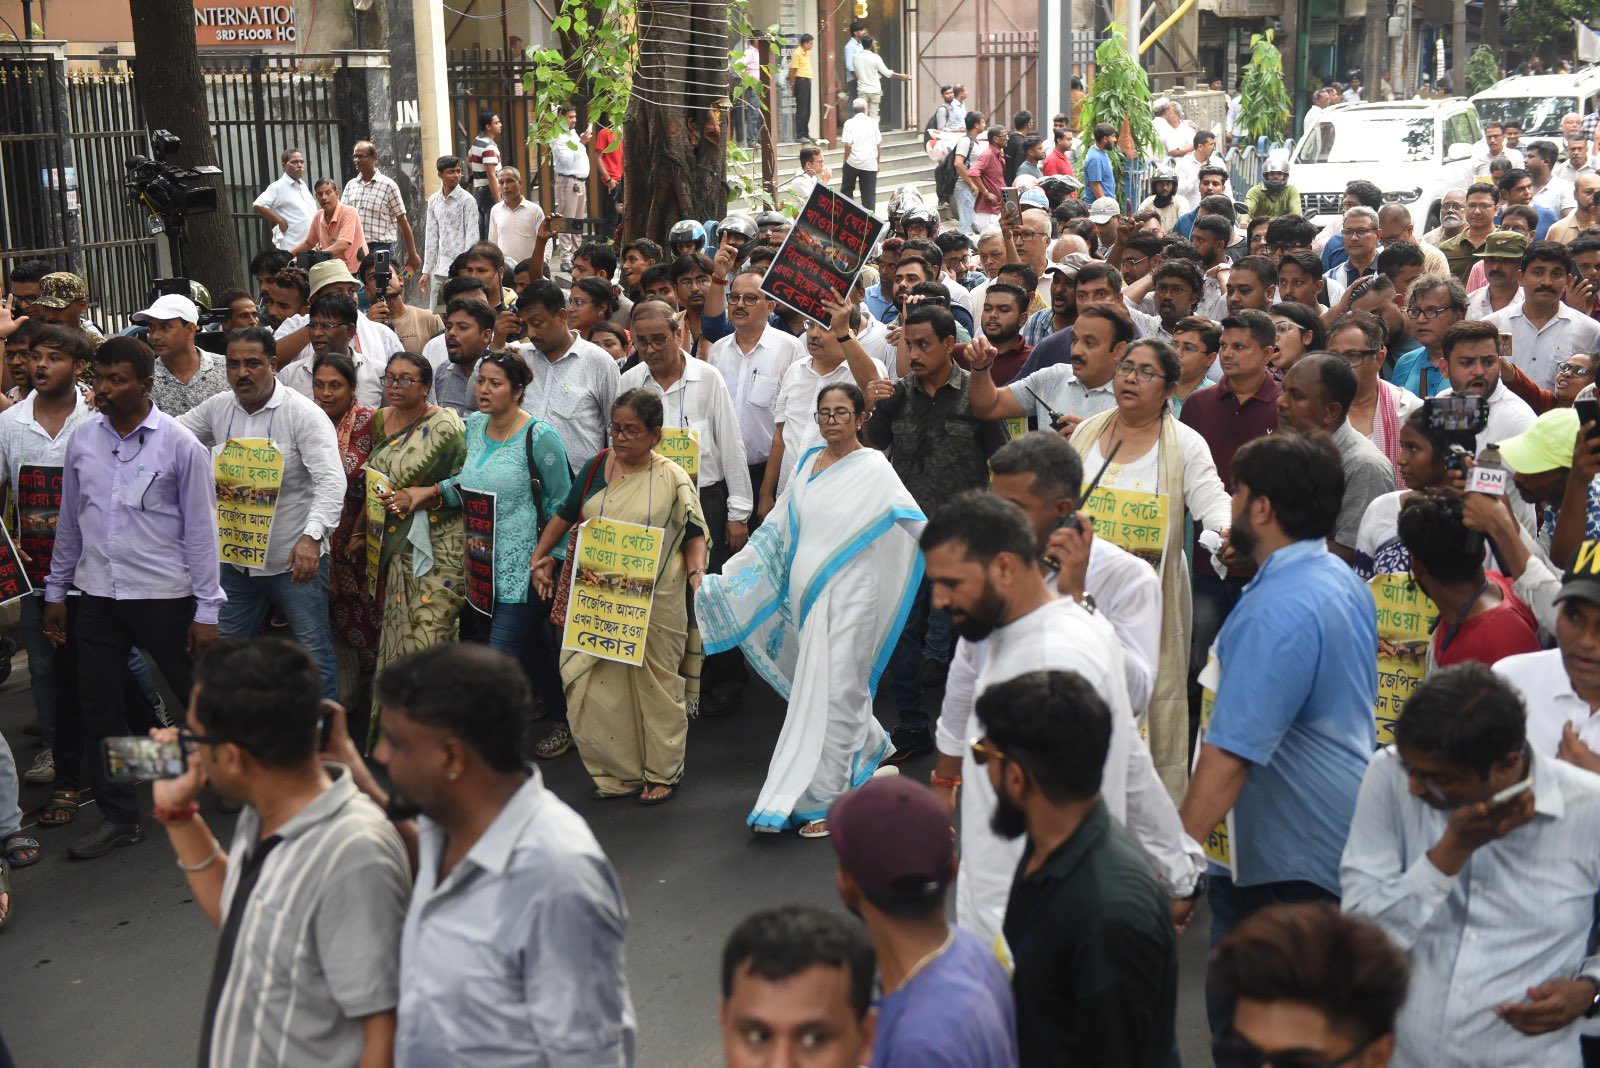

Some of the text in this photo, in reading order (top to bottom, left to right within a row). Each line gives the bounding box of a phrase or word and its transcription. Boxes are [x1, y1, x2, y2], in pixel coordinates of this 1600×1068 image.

[194, 6, 295, 26] NTERNATIO
[216, 29, 236, 41] 3RD
[239, 28, 272, 40] FLOOR
[806, 208, 839, 235] খাওয়া
[817, 193, 873, 238] আমি খেটে
[783, 245, 821, 277] বিজেপির
[772, 281, 826, 319] বেকার
[223, 444, 277, 462] আমি খেটে
[219, 462, 279, 481] খাওয়া হকার
[1480, 472, 1502, 483] DN
[217, 504, 247, 525] বিজেপির
[1087, 491, 1159, 520] আমি খেটে
[591, 525, 655, 552] আমি খেটে
[1121, 523, 1161, 543] হকার
[585, 546, 655, 573] খাওয়া হকার
[577, 590, 647, 621] বিজেপির আমলে
[1382, 579, 1418, 607] আমি
[572, 613, 644, 640] এখন উচ্ছেদ হওয়া
[577, 631, 637, 657] বেকার
